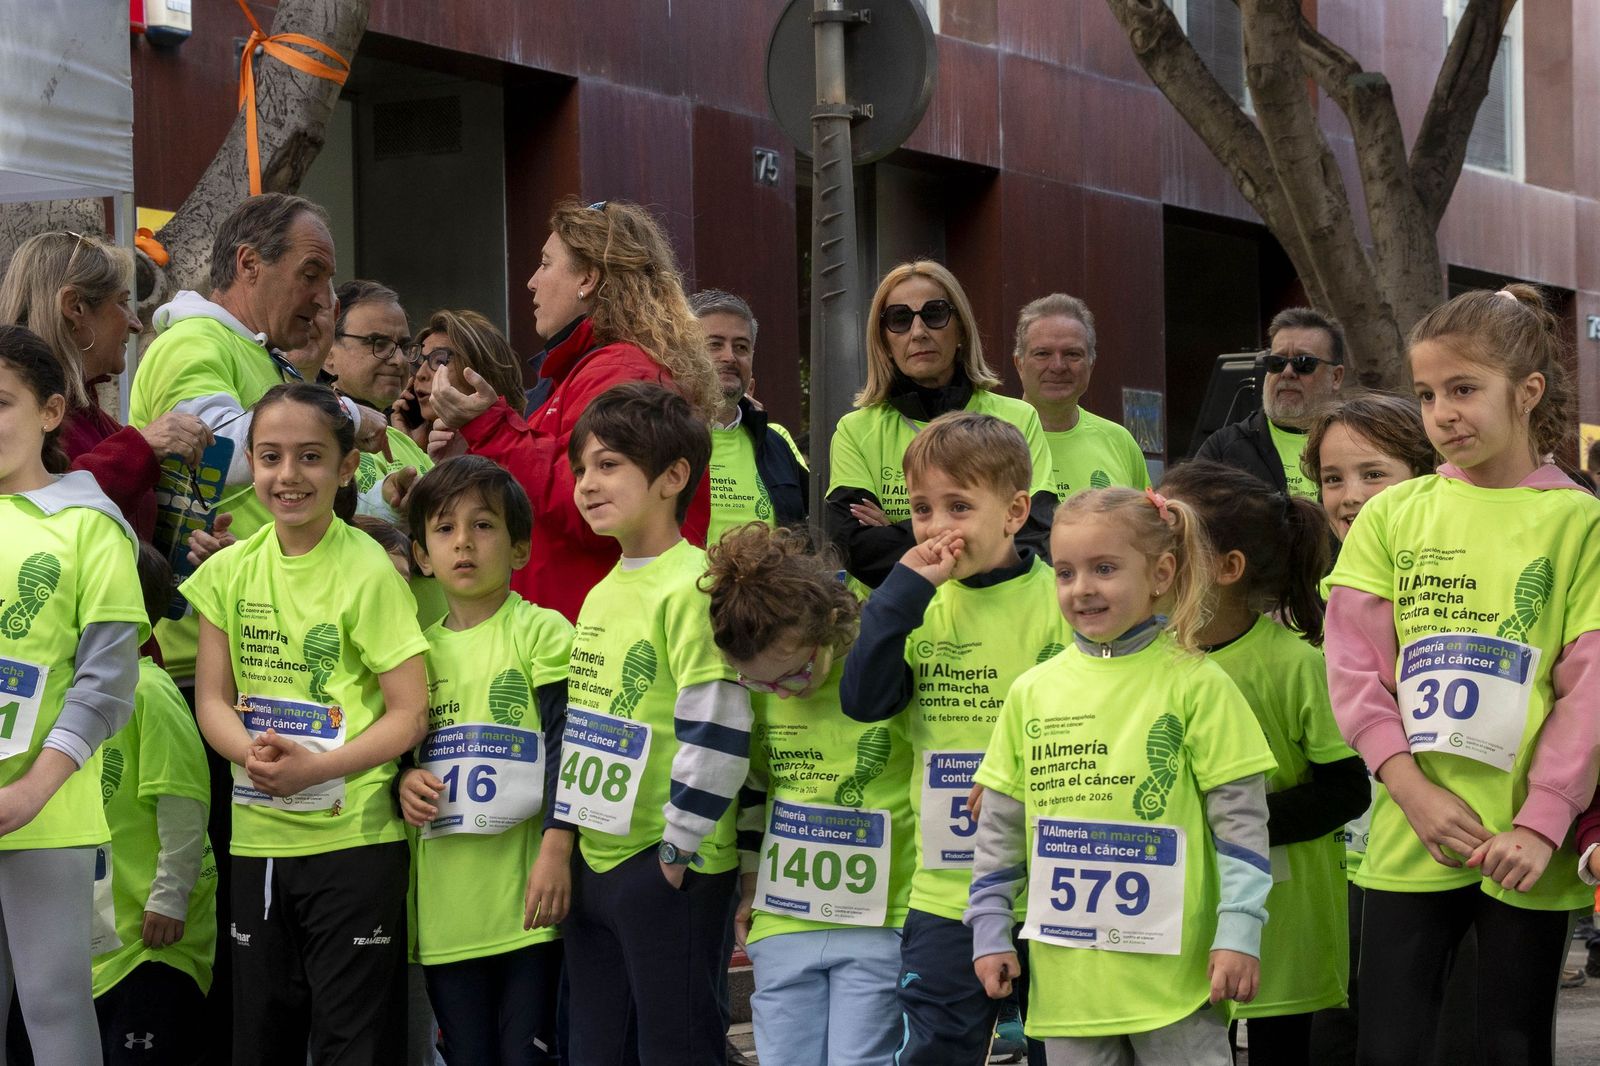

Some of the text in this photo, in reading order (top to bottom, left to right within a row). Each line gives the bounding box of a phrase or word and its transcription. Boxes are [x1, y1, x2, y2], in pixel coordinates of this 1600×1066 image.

[756, 150, 778, 180] 75
[1412, 574, 1476, 590] Almería
[1399, 596, 1415, 606] en
[1400, 607, 1500, 622] contra el cáncer
[1412, 641, 1444, 658] Almería
[1446, 642, 1462, 650] en
[1466, 643, 1517, 660] marcha
[240, 656, 262, 667] cntra
[1408, 654, 1495, 673] contra el cáncer
[0, 666, 24, 678] rcha
[919, 663, 998, 681] II Almería
[273, 676, 293, 684] 2026
[568, 677, 613, 698] tra el cáncer
[919, 682, 989, 694] en marcha
[919, 696, 1004, 709] contra el cán
[1412, 678, 1480, 720] 30
[284, 707, 327, 721] marcha
[928, 714, 936, 722] de
[939, 713, 969, 722] febrero
[972, 714, 983, 722] de
[273, 719, 308, 730] cáncer
[429, 717, 454, 730] archa
[600, 724, 633, 738] marcha
[433, 732, 464, 743] Almería
[466, 731, 478, 740] en
[482, 732, 525, 744] marcha
[579, 731, 586, 740] el
[588, 733, 617, 748] cáncer
[428, 743, 508, 757] contra el cáncer
[1032, 739, 1108, 761] II Almería
[774, 760, 816, 772] marcha
[938, 758, 982, 768] II Almerí
[1030, 758, 1096, 775] en marcha
[560, 748, 631, 803] 408
[790, 771, 840, 782] el cáncer
[1030, 773, 1136, 791] contra el cáncer
[443, 764, 497, 803] 16
[1038, 799, 1047, 807] de
[1049, 794, 1073, 805] febrero
[1076, 793, 1086, 802] de
[1089, 793, 1113, 801] 2026
[778, 807, 806, 822] Almería
[808, 814, 822, 823] en
[826, 815, 871, 828] marcha
[775, 821, 852, 840] contra el cáncer
[1049, 826, 1088, 840] Almería
[1090, 831, 1106, 840] en
[1110, 831, 1161, 844] marcha
[1045, 842, 1141, 857] contra el cáncer
[766, 842, 877, 895] 1409
[1050, 867, 1150, 916] 579
